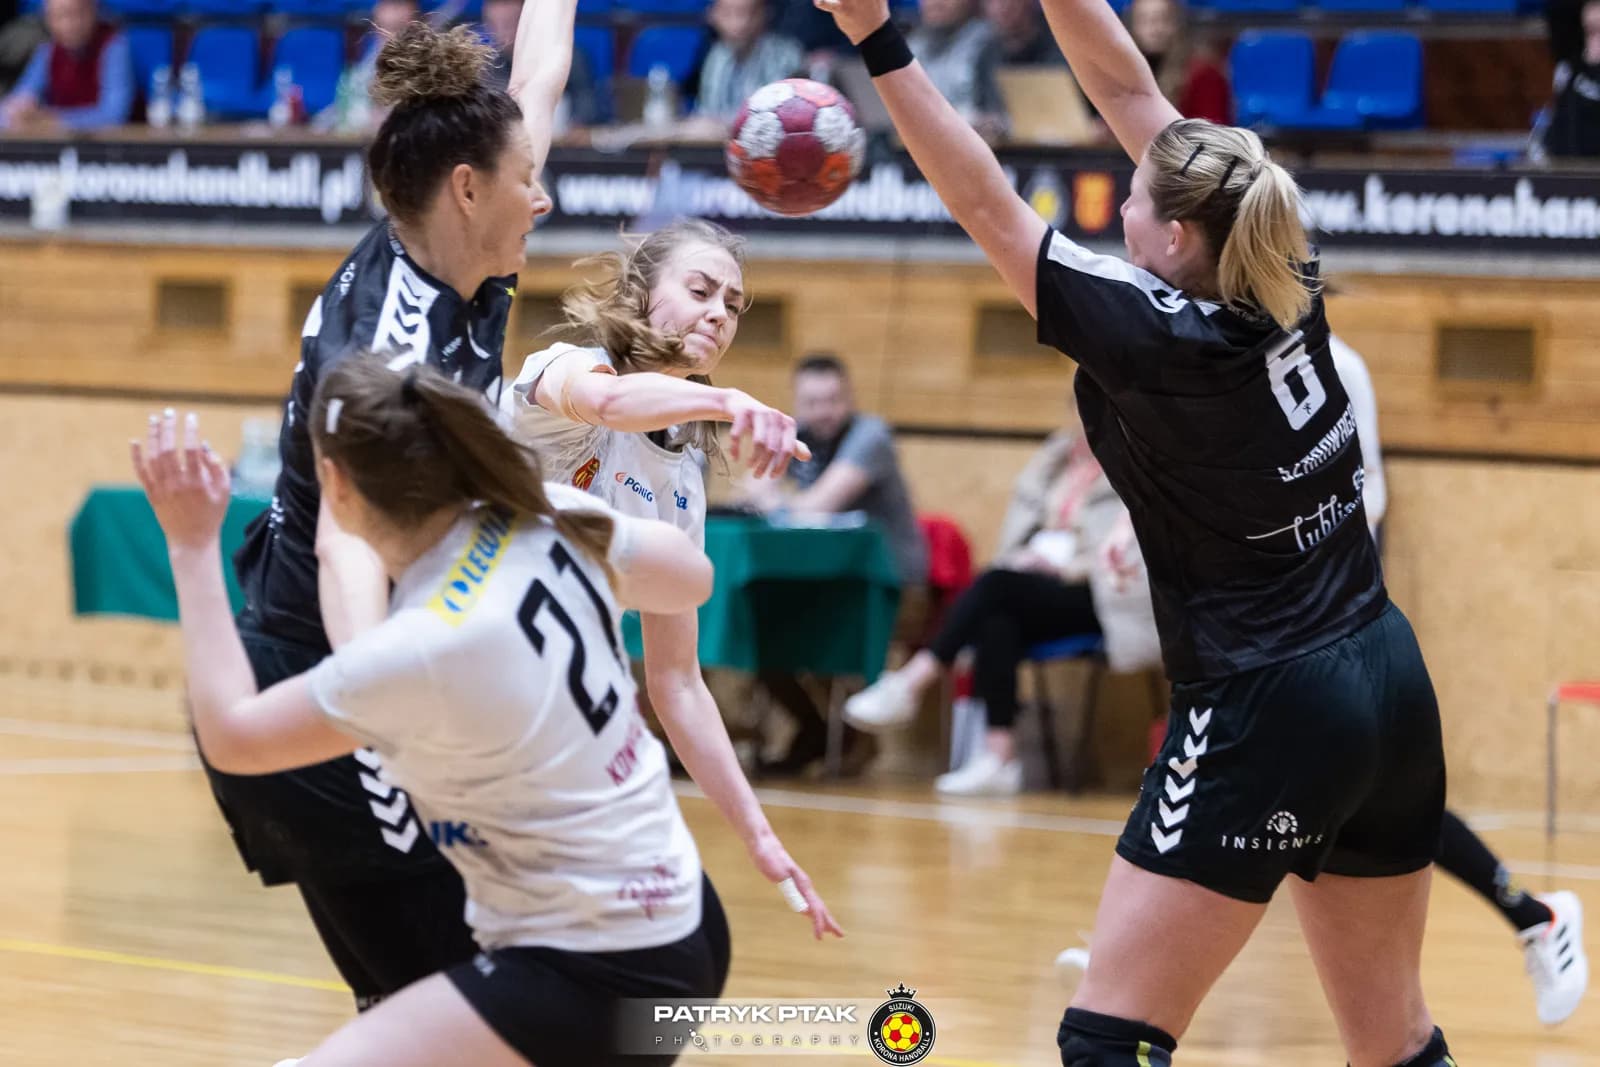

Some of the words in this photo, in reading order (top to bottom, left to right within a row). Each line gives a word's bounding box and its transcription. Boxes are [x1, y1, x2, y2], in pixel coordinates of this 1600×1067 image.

[1265, 330, 1326, 431] 6
[517, 540, 626, 737] 21
[1221, 835, 1323, 851] INSIGNIS
